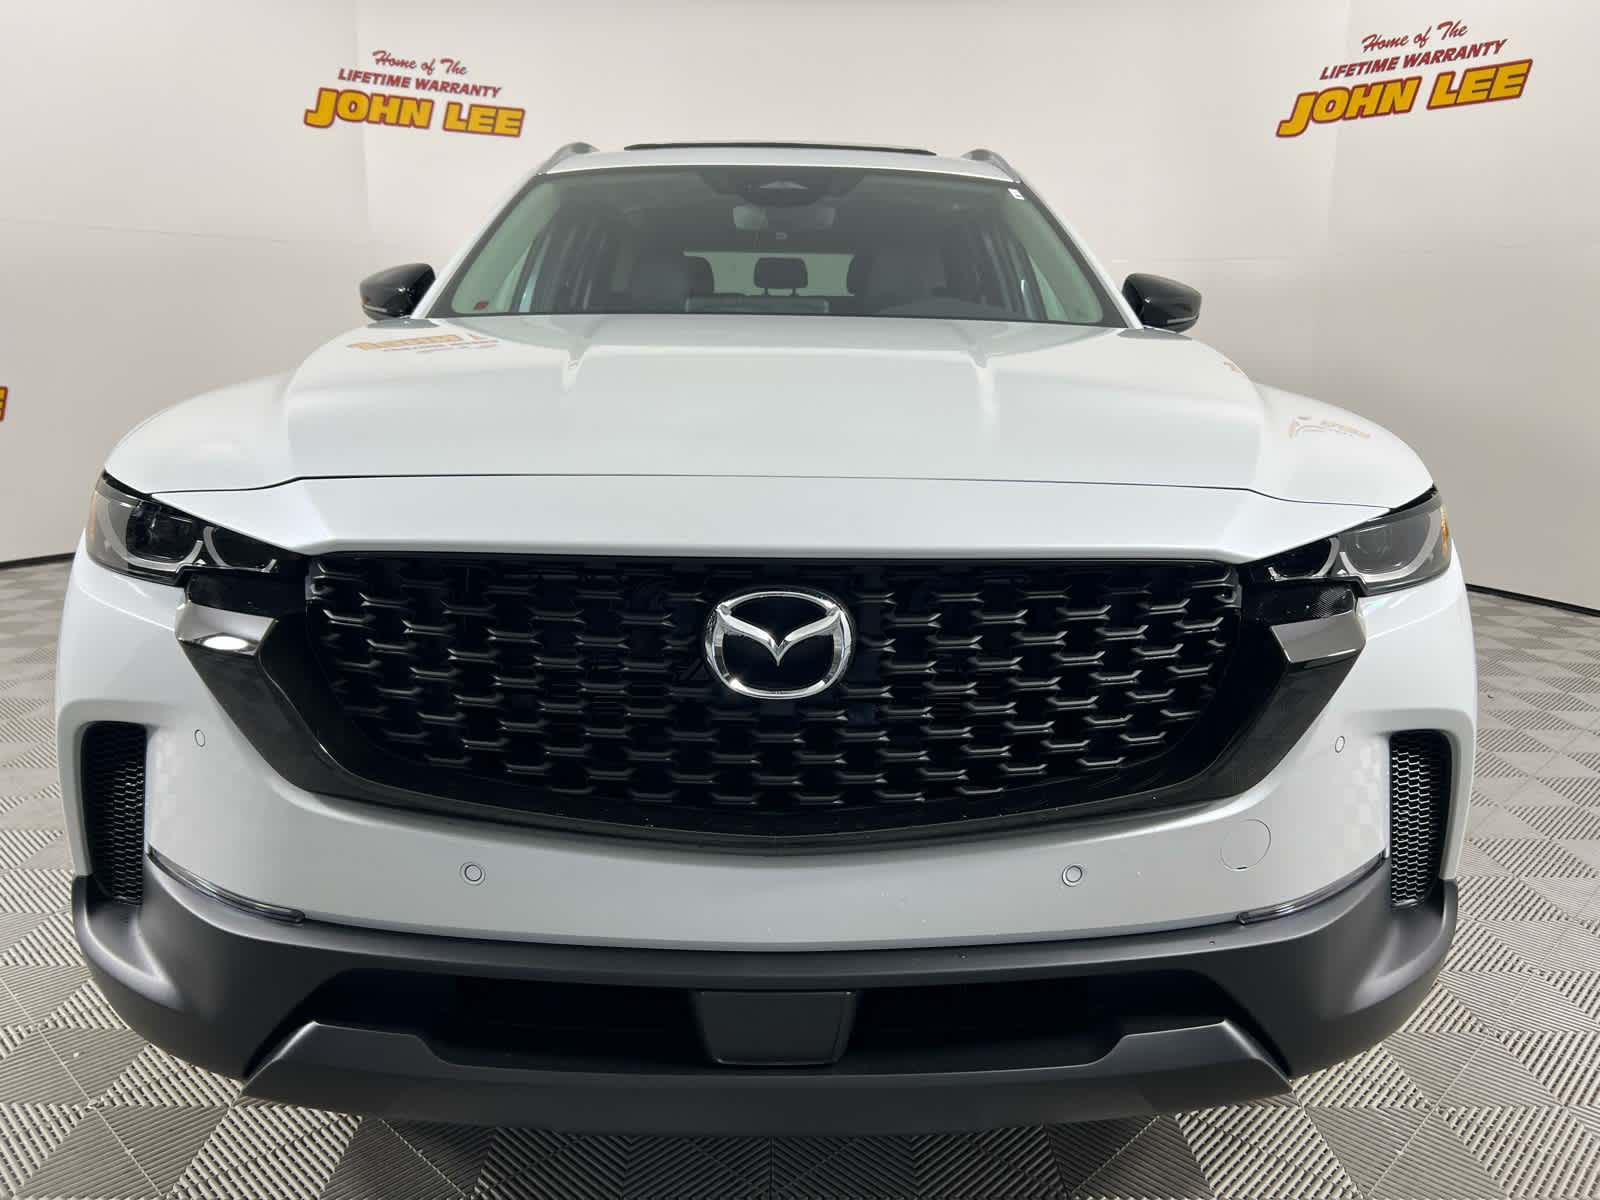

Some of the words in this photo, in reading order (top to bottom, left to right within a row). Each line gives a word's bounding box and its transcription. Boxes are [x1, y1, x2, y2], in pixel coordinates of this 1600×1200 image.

[1361, 33, 1409, 53] Home
[1413, 26, 1432, 48] of
[1436, 19, 1468, 38] The
[372, 50, 417, 69] Home
[421, 59, 436, 75] of
[440, 58, 468, 75] The
[1319, 56, 1400, 80] LIFETIME
[1402, 39, 1508, 69] WARRANTY
[338, 68, 412, 88] LIFETIME
[415, 77, 502, 98] WARRANTY
[1275, 75, 1422, 138] JOHN
[1426, 58, 1533, 110] LEE
[303, 87, 435, 129] JOHN
[442, 101, 525, 137] LEE
